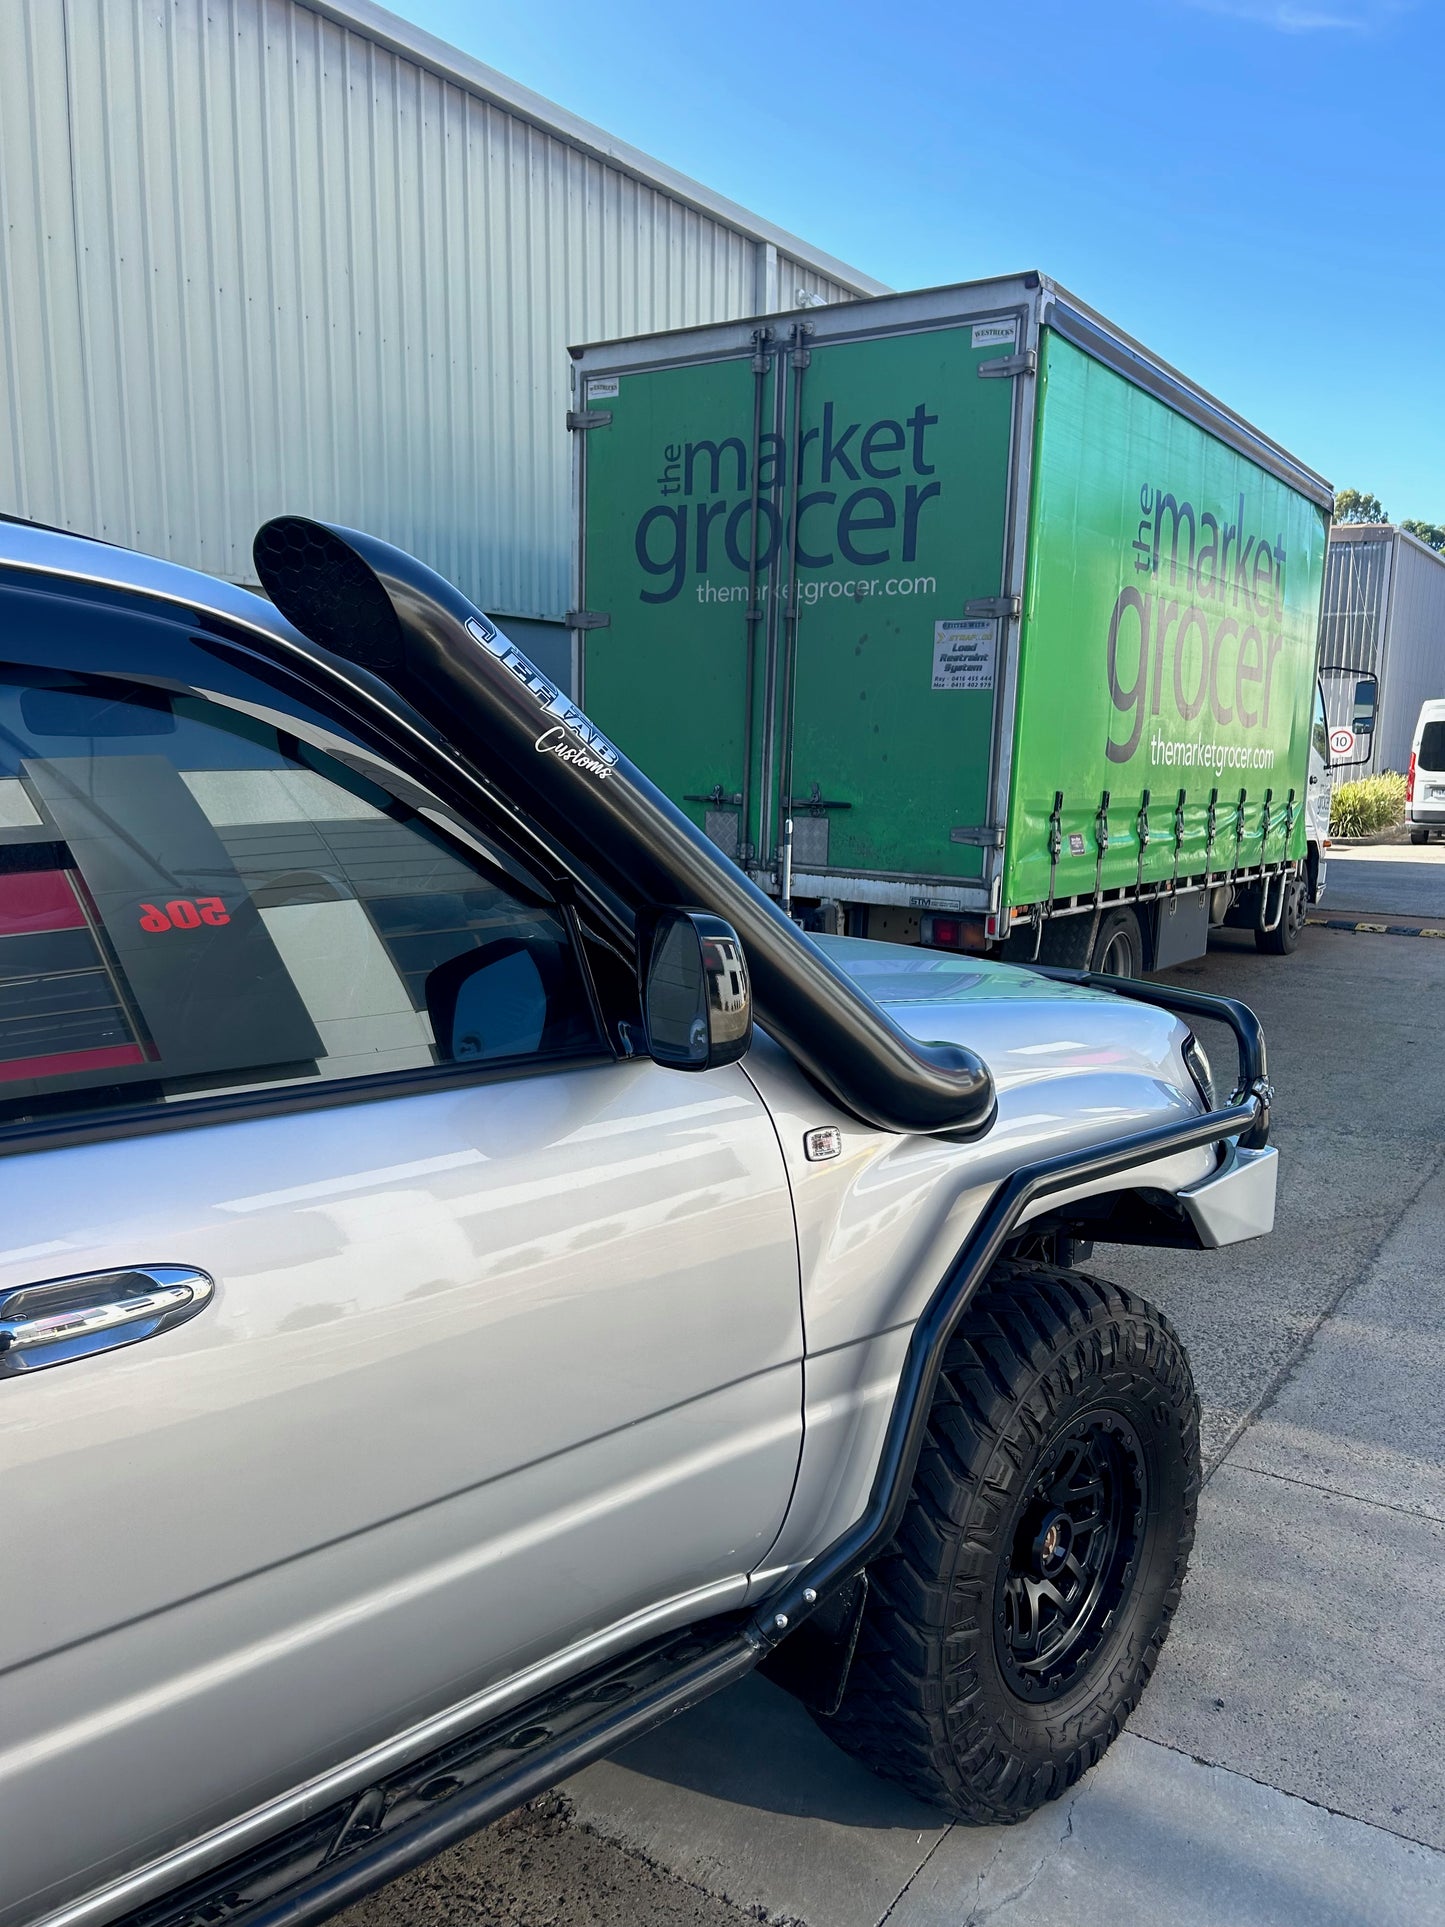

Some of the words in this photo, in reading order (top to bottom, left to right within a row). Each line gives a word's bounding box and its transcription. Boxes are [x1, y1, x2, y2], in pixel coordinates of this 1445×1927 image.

[657, 443, 681, 496] the
[684, 401, 939, 496] market
[635, 481, 941, 604] grocer
[1132, 483, 1153, 574] the
[1153, 489, 1287, 623] market
[939, 653, 989, 662] Restraint
[944, 664, 983, 674] System
[952, 643, 978, 652] Load
[1106, 585, 1283, 764] grocer
[534, 726, 613, 779] Customs
[1151, 727, 1274, 777] themarketgrocer.com
[1336, 736, 1347, 747] 10
